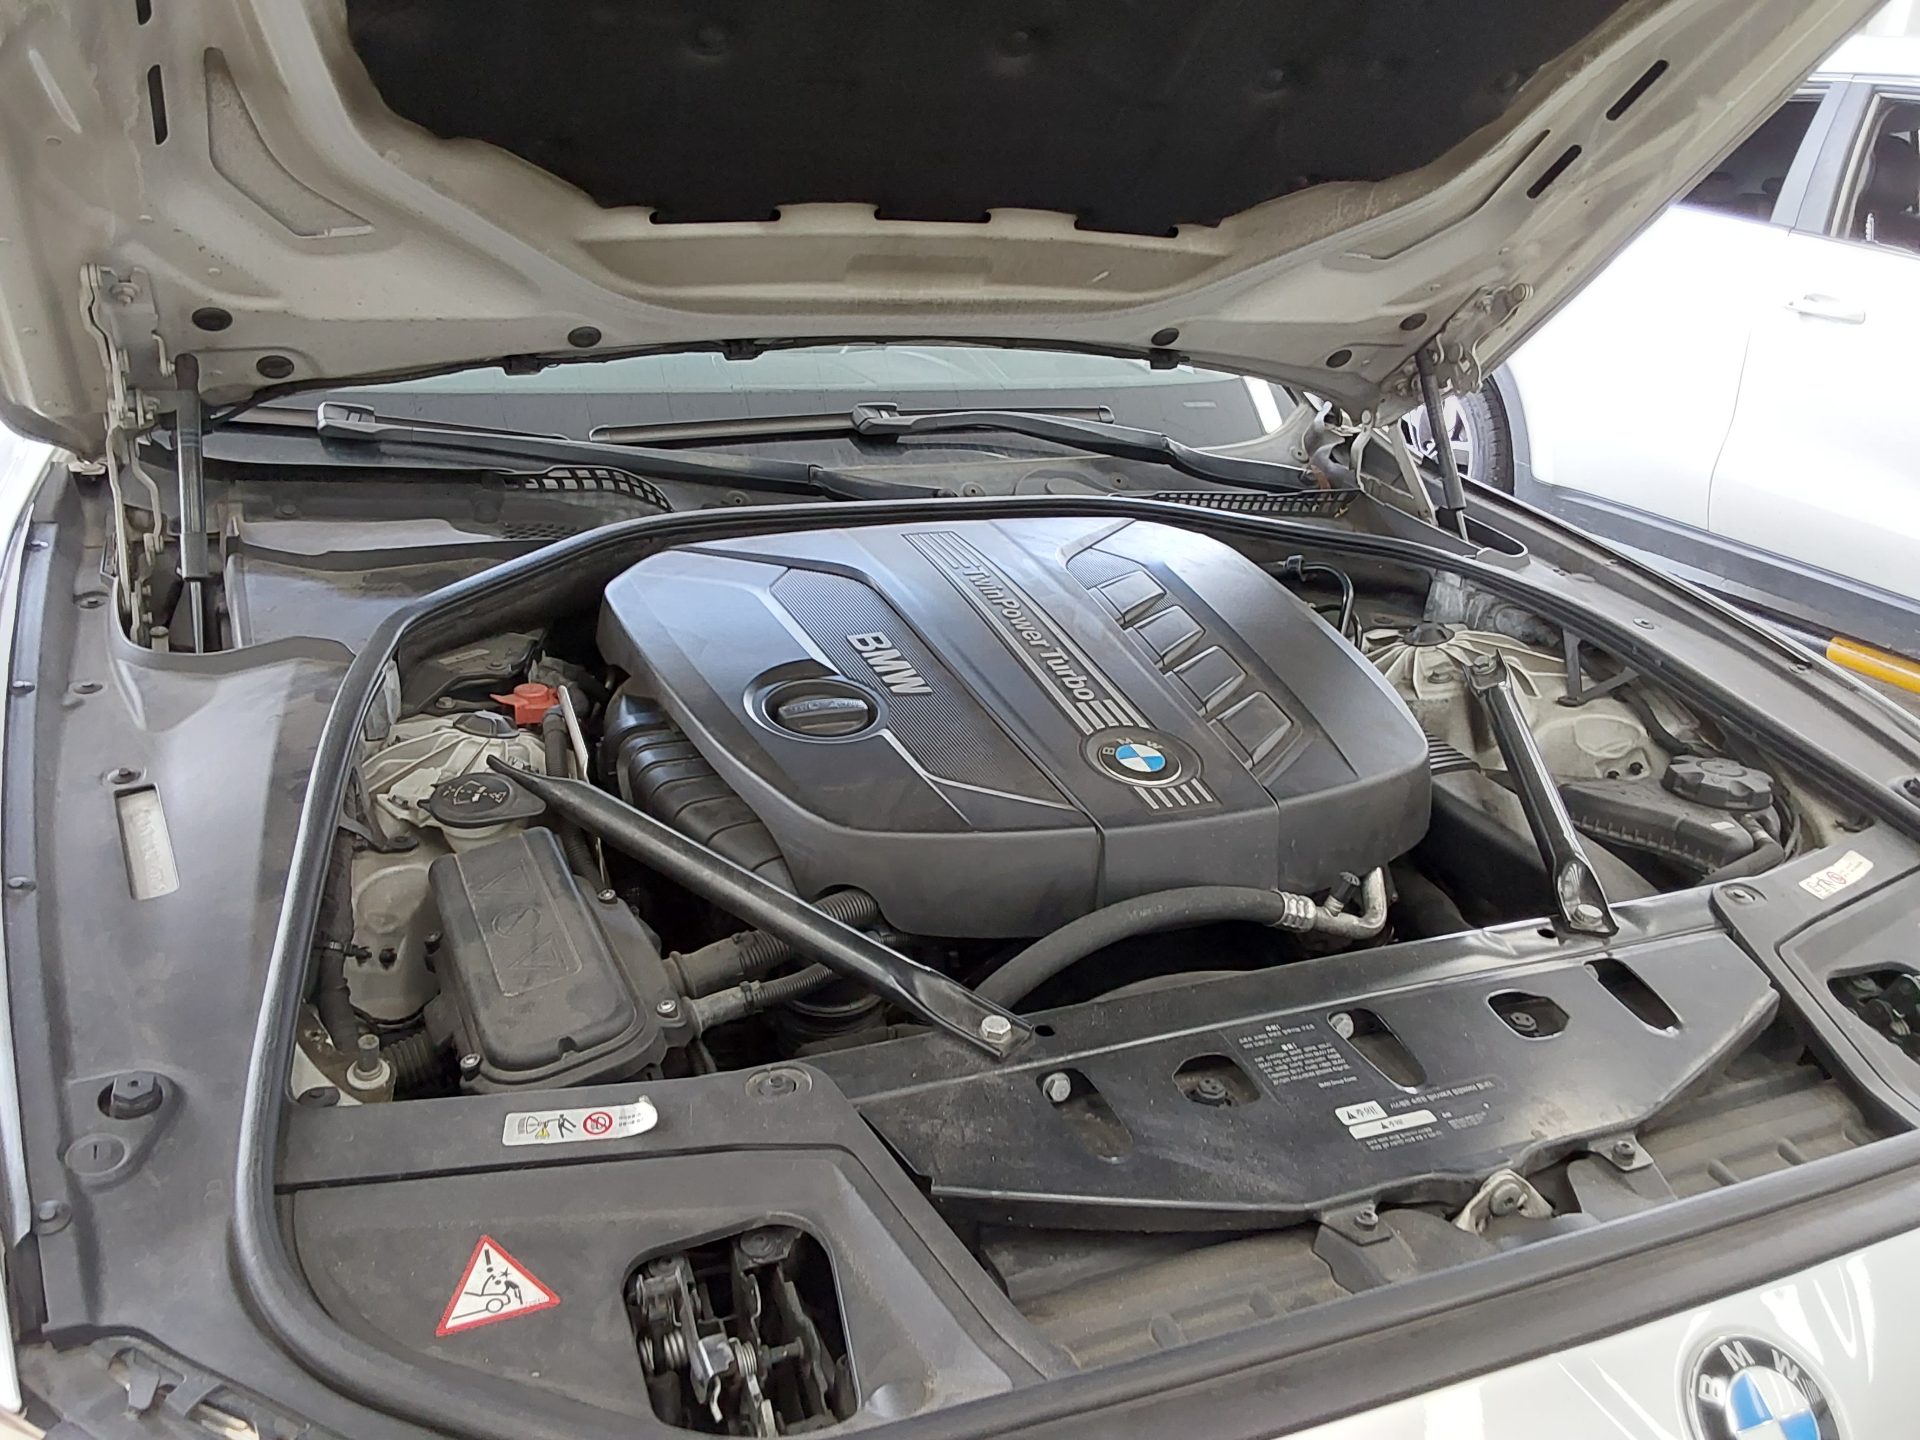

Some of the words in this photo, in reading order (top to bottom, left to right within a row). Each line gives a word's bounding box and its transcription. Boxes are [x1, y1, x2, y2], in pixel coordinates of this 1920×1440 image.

[847, 631, 933, 694] BMW
[963, 565, 1050, 649] TwinPower
[1040, 647, 1095, 701] Turbo
[1102, 736, 1164, 756] BMW
[1698, 1340, 1800, 1402] BMW
